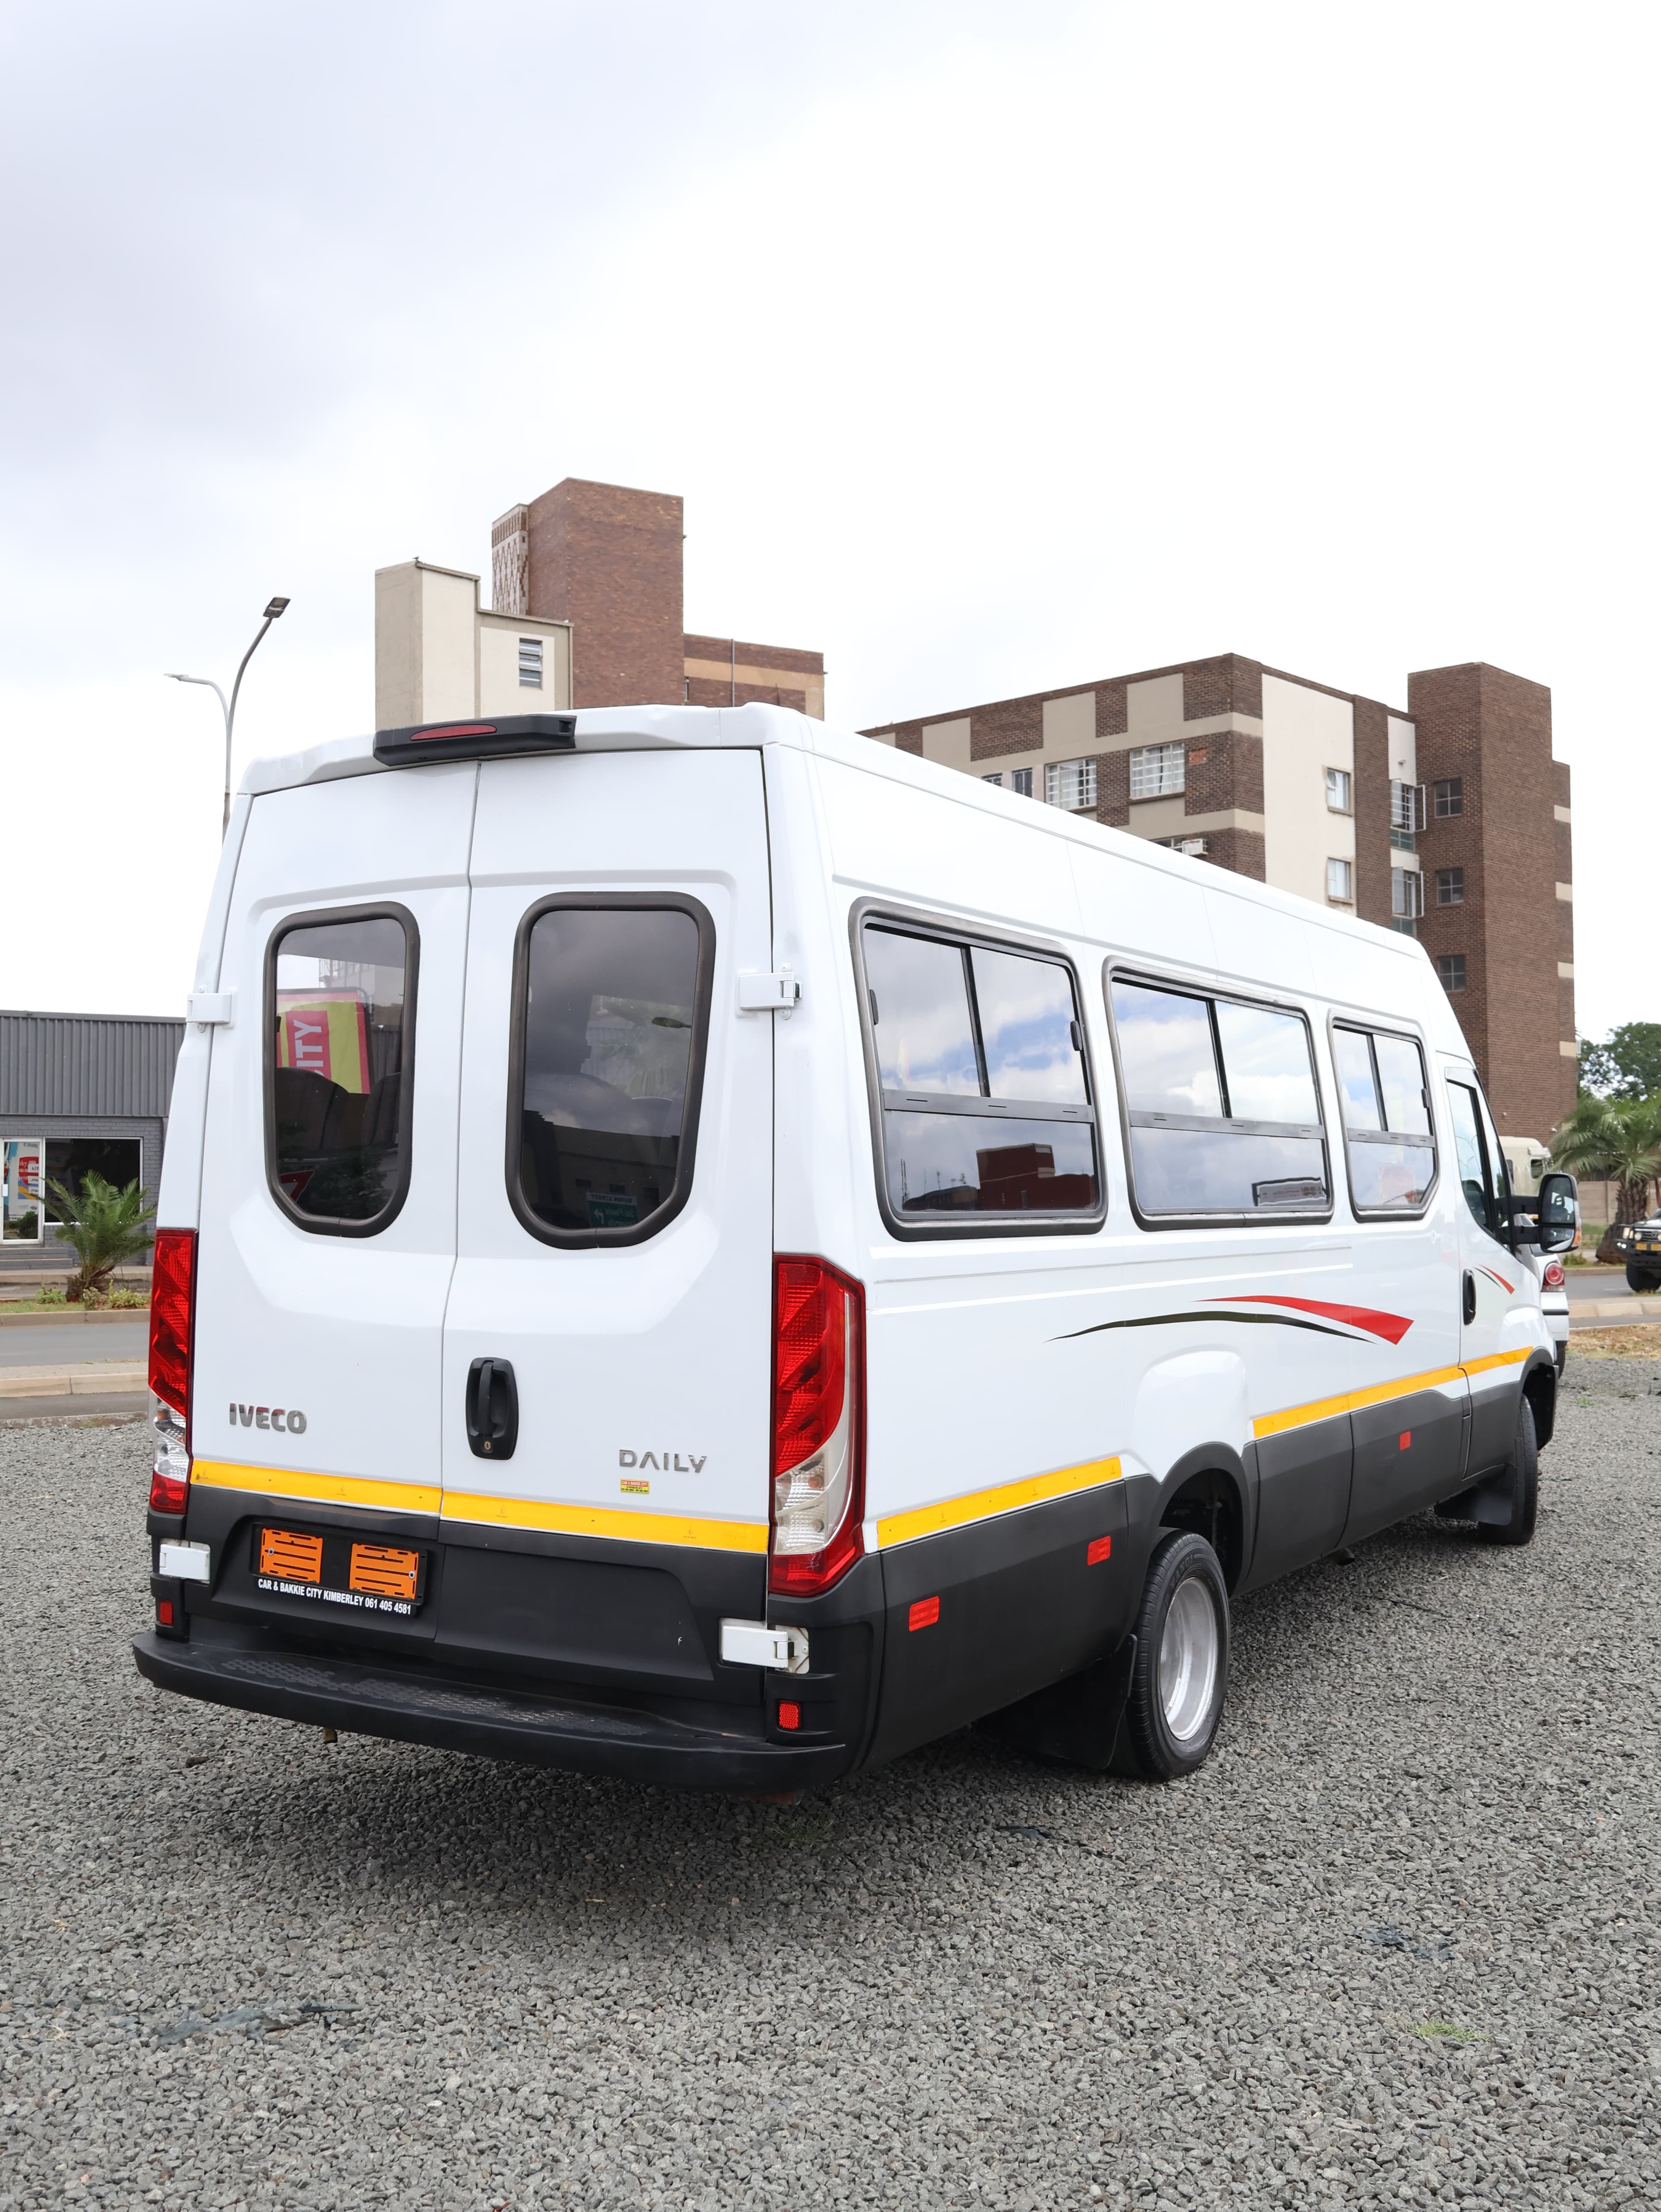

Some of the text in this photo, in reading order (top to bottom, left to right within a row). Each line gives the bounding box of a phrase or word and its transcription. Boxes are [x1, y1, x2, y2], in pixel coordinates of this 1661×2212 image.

[293, 1019, 324, 1077] ITY
[230, 1403, 307, 1434] IVECO
[619, 1449, 707, 1473] DAILY
[258, 1578, 411, 1614] CAR & BAKKIE CITY KIMBERLEY 061 405 4581
